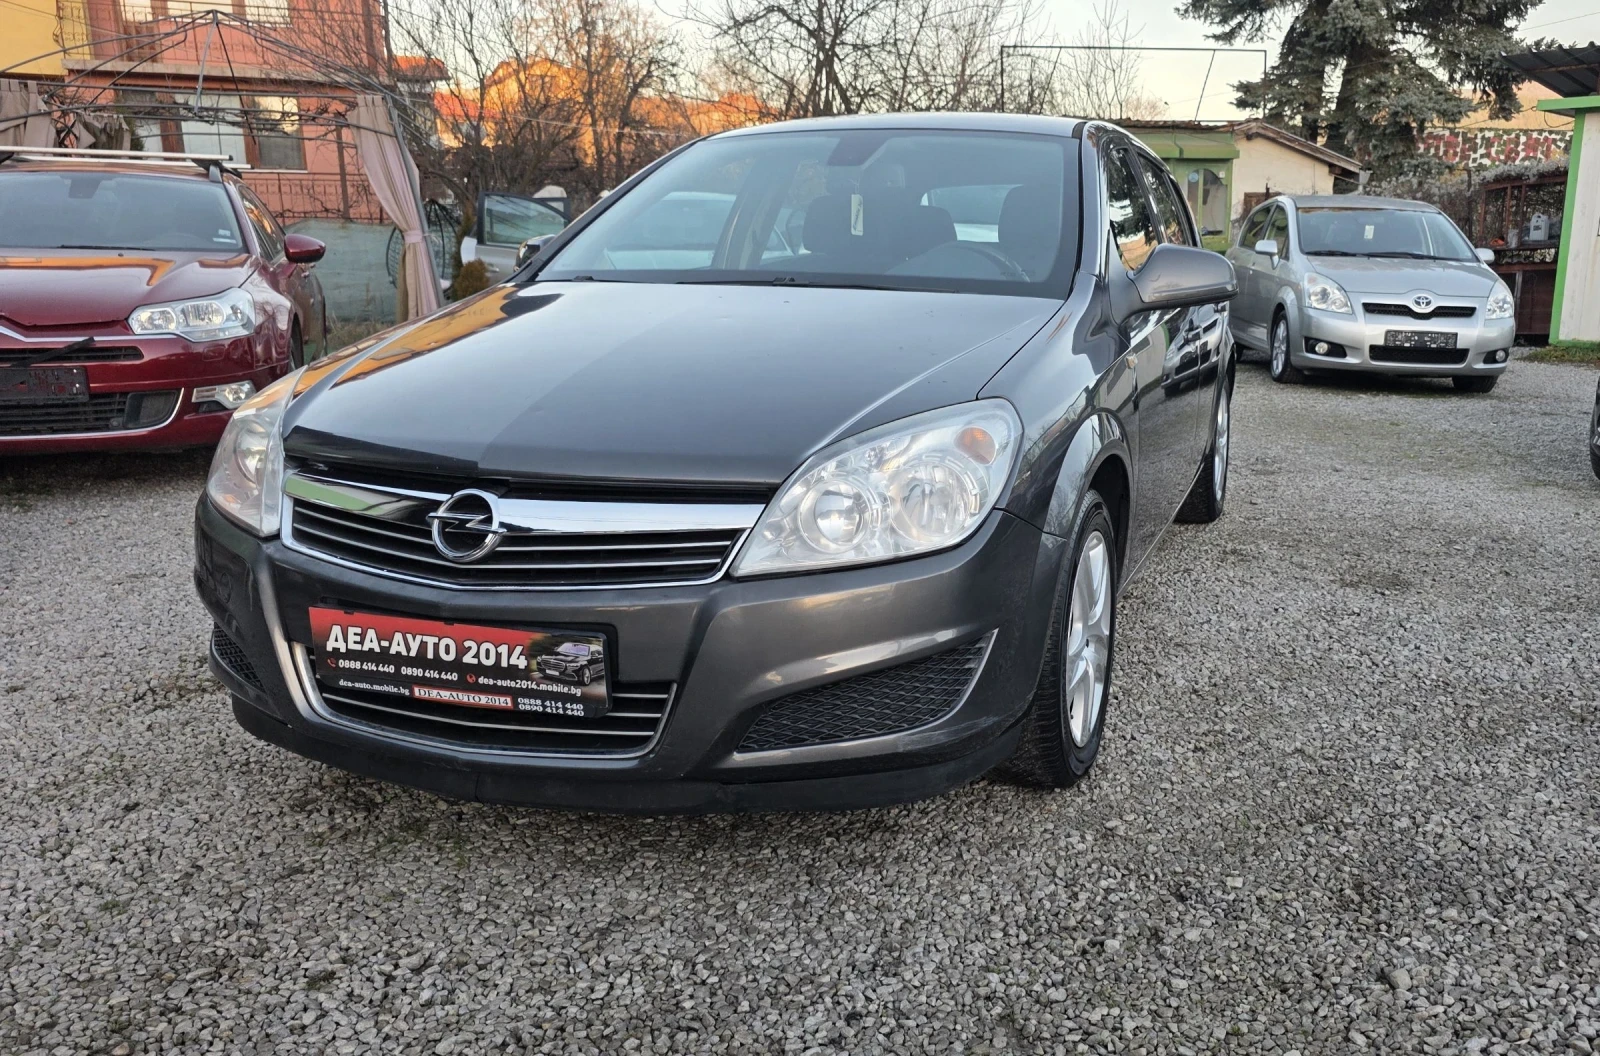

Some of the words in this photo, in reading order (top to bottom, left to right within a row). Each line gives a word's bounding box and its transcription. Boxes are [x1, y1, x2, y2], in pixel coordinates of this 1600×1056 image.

[326, 624, 457, 662] ДЕА-АУТО
[462, 639, 528, 670] 2014
[338, 659, 361, 669] 0888
[362, 662, 377, 672] 414
[378, 663, 395, 674] 440
[401, 666, 424, 677] 0890
[424, 669, 440, 679] 414
[440, 671, 459, 681] 440
[338, 678, 410, 696] dea-auto.mobile.bg
[478, 675, 582, 697] dea-auto2014.mobile.bg
[418, 688, 482, 703] DEA-AUTO
[485, 696, 509, 706] 2014
[517, 697, 542, 706] 0888
[544, 700, 563, 708] 414
[565, 702, 584, 710] 440
[519, 704, 544, 713] 0890
[545, 706, 564, 715] 414
[566, 709, 584, 717] 440
